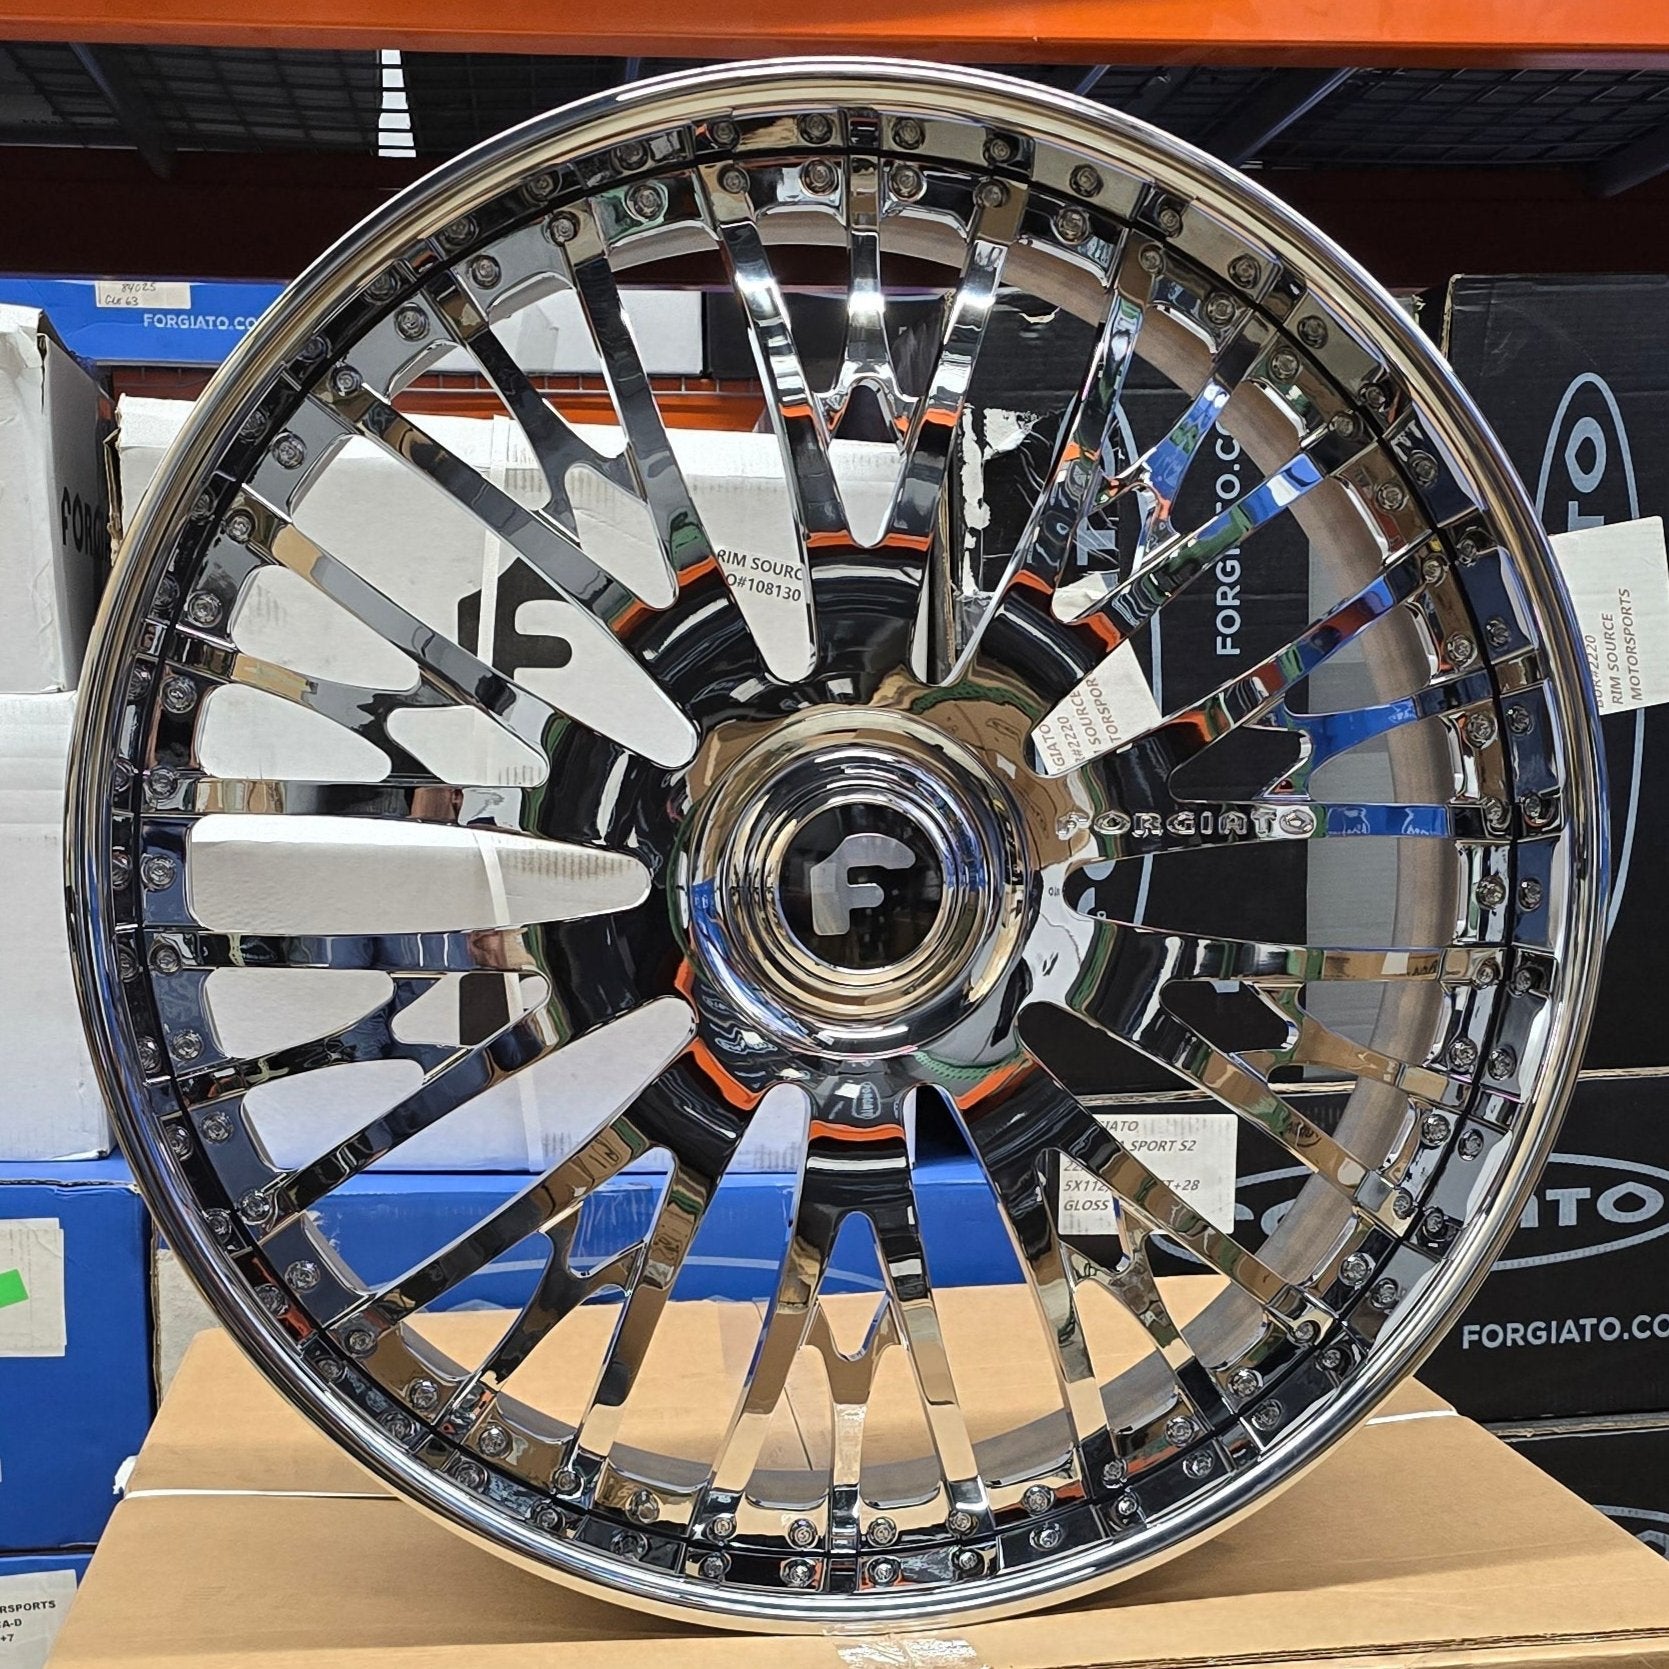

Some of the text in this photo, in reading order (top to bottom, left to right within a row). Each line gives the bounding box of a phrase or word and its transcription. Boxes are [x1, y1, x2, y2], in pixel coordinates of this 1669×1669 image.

[717, 549, 747, 568] RIM
[1618, 588, 1643, 701] MOTORSPORTS
[1601, 613, 1624, 705] RIM SOURCE
[1069, 690, 1102, 745] SOURCE
[1056, 809, 1317, 841] FORGIATO
[1129, 1140, 1178, 1151] SPORT
[1178, 1140, 1197, 1151] S2
[1063, 1200, 1109, 1211] GLOSS
[0, 1600, 56, 1614] RSPORTS
